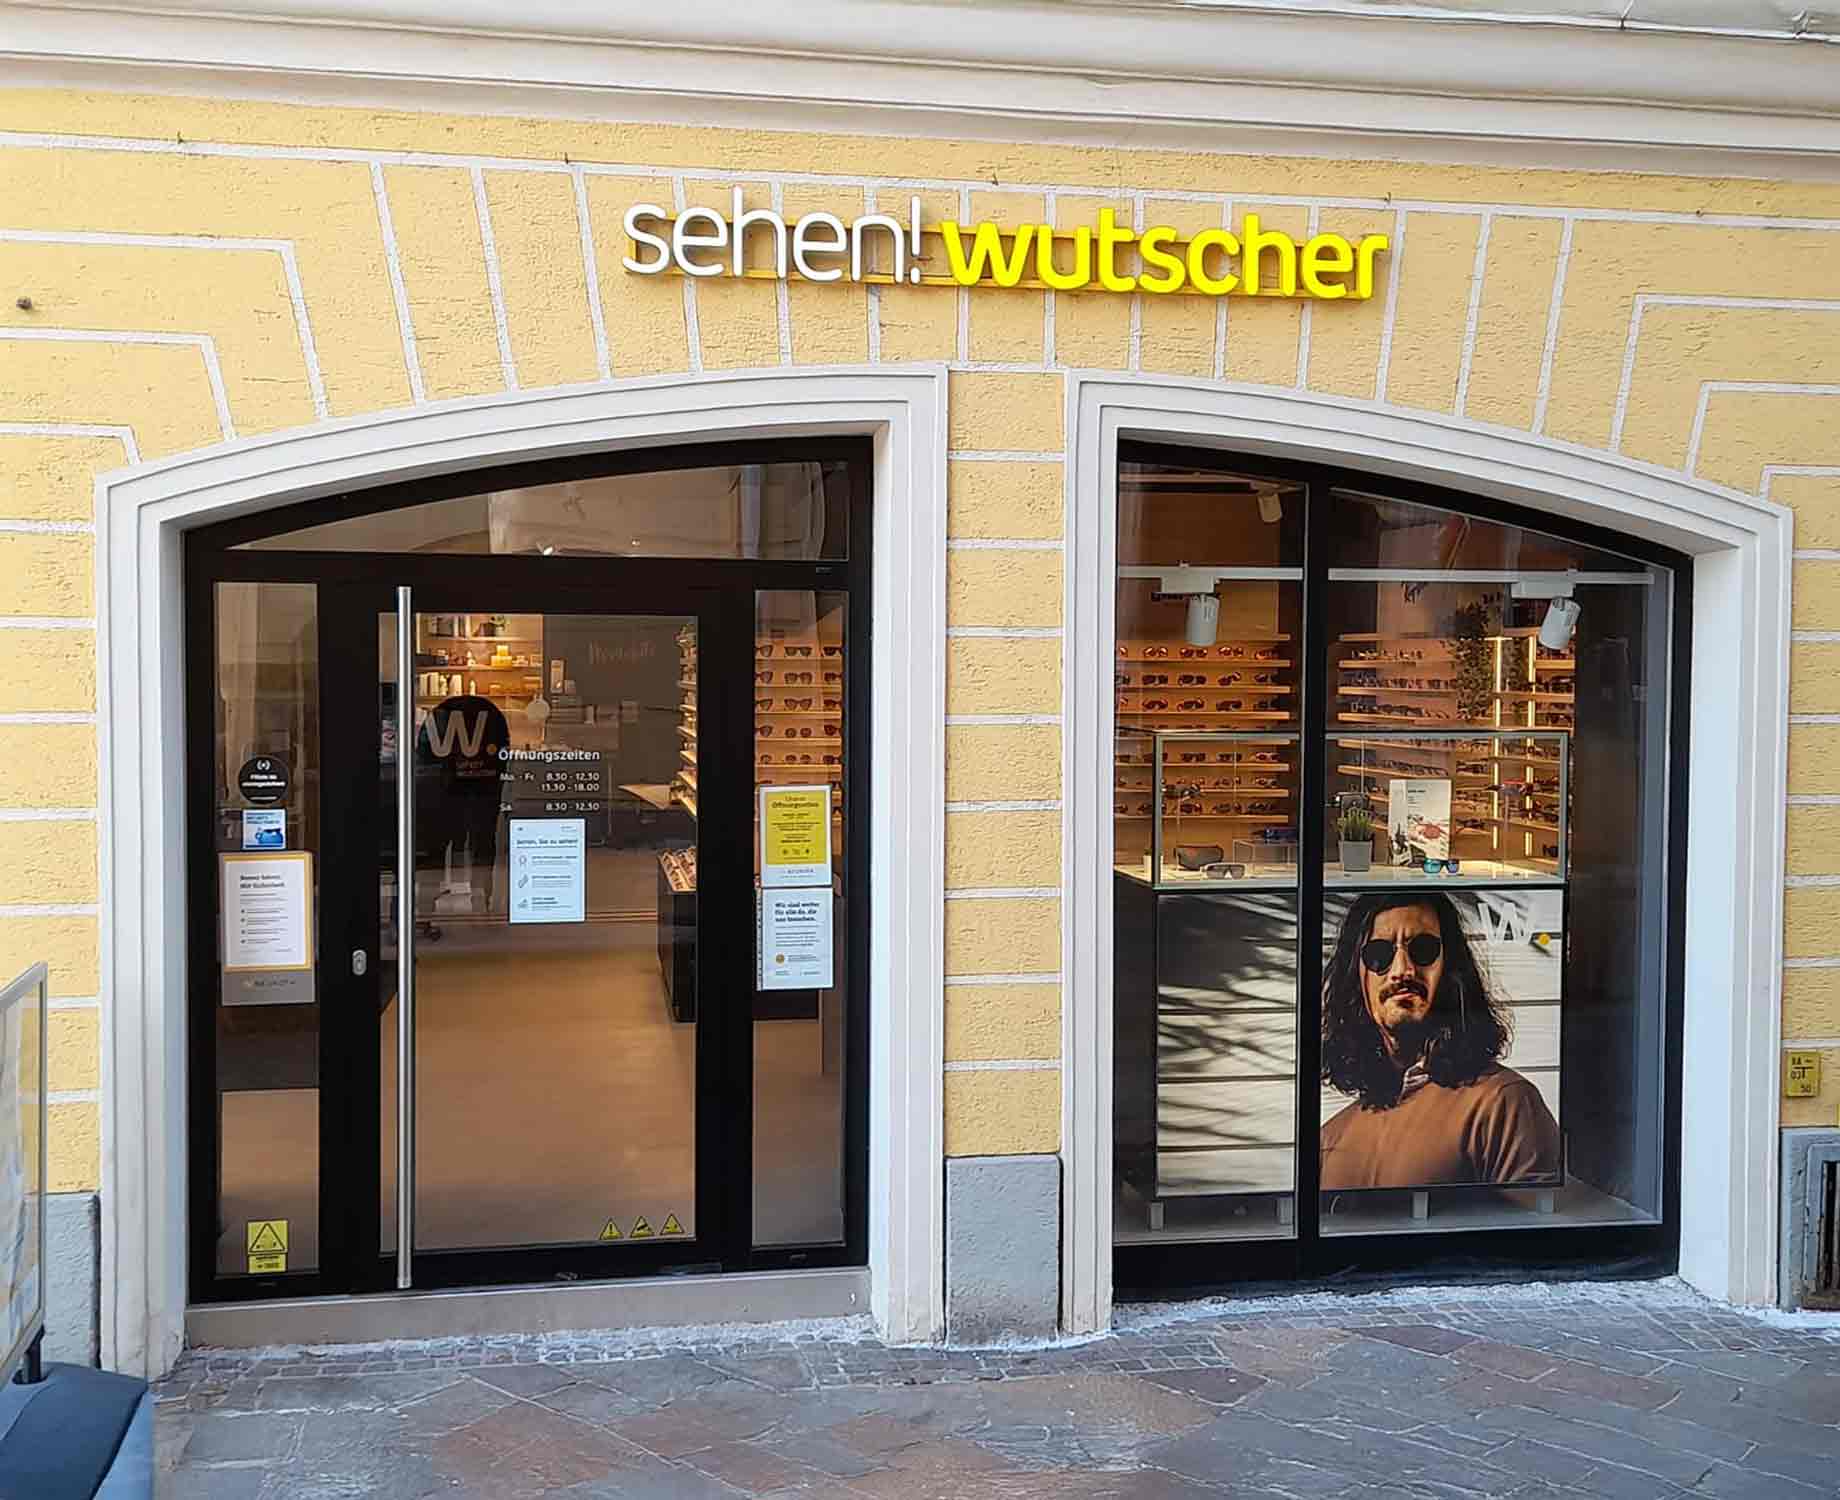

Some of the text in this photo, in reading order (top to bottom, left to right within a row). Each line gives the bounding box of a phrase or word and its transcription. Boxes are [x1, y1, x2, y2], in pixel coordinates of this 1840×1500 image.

[622, 186, 1389, 299] sehen! wutscher
[498, 747, 600, 763] Öffnungszeiten
